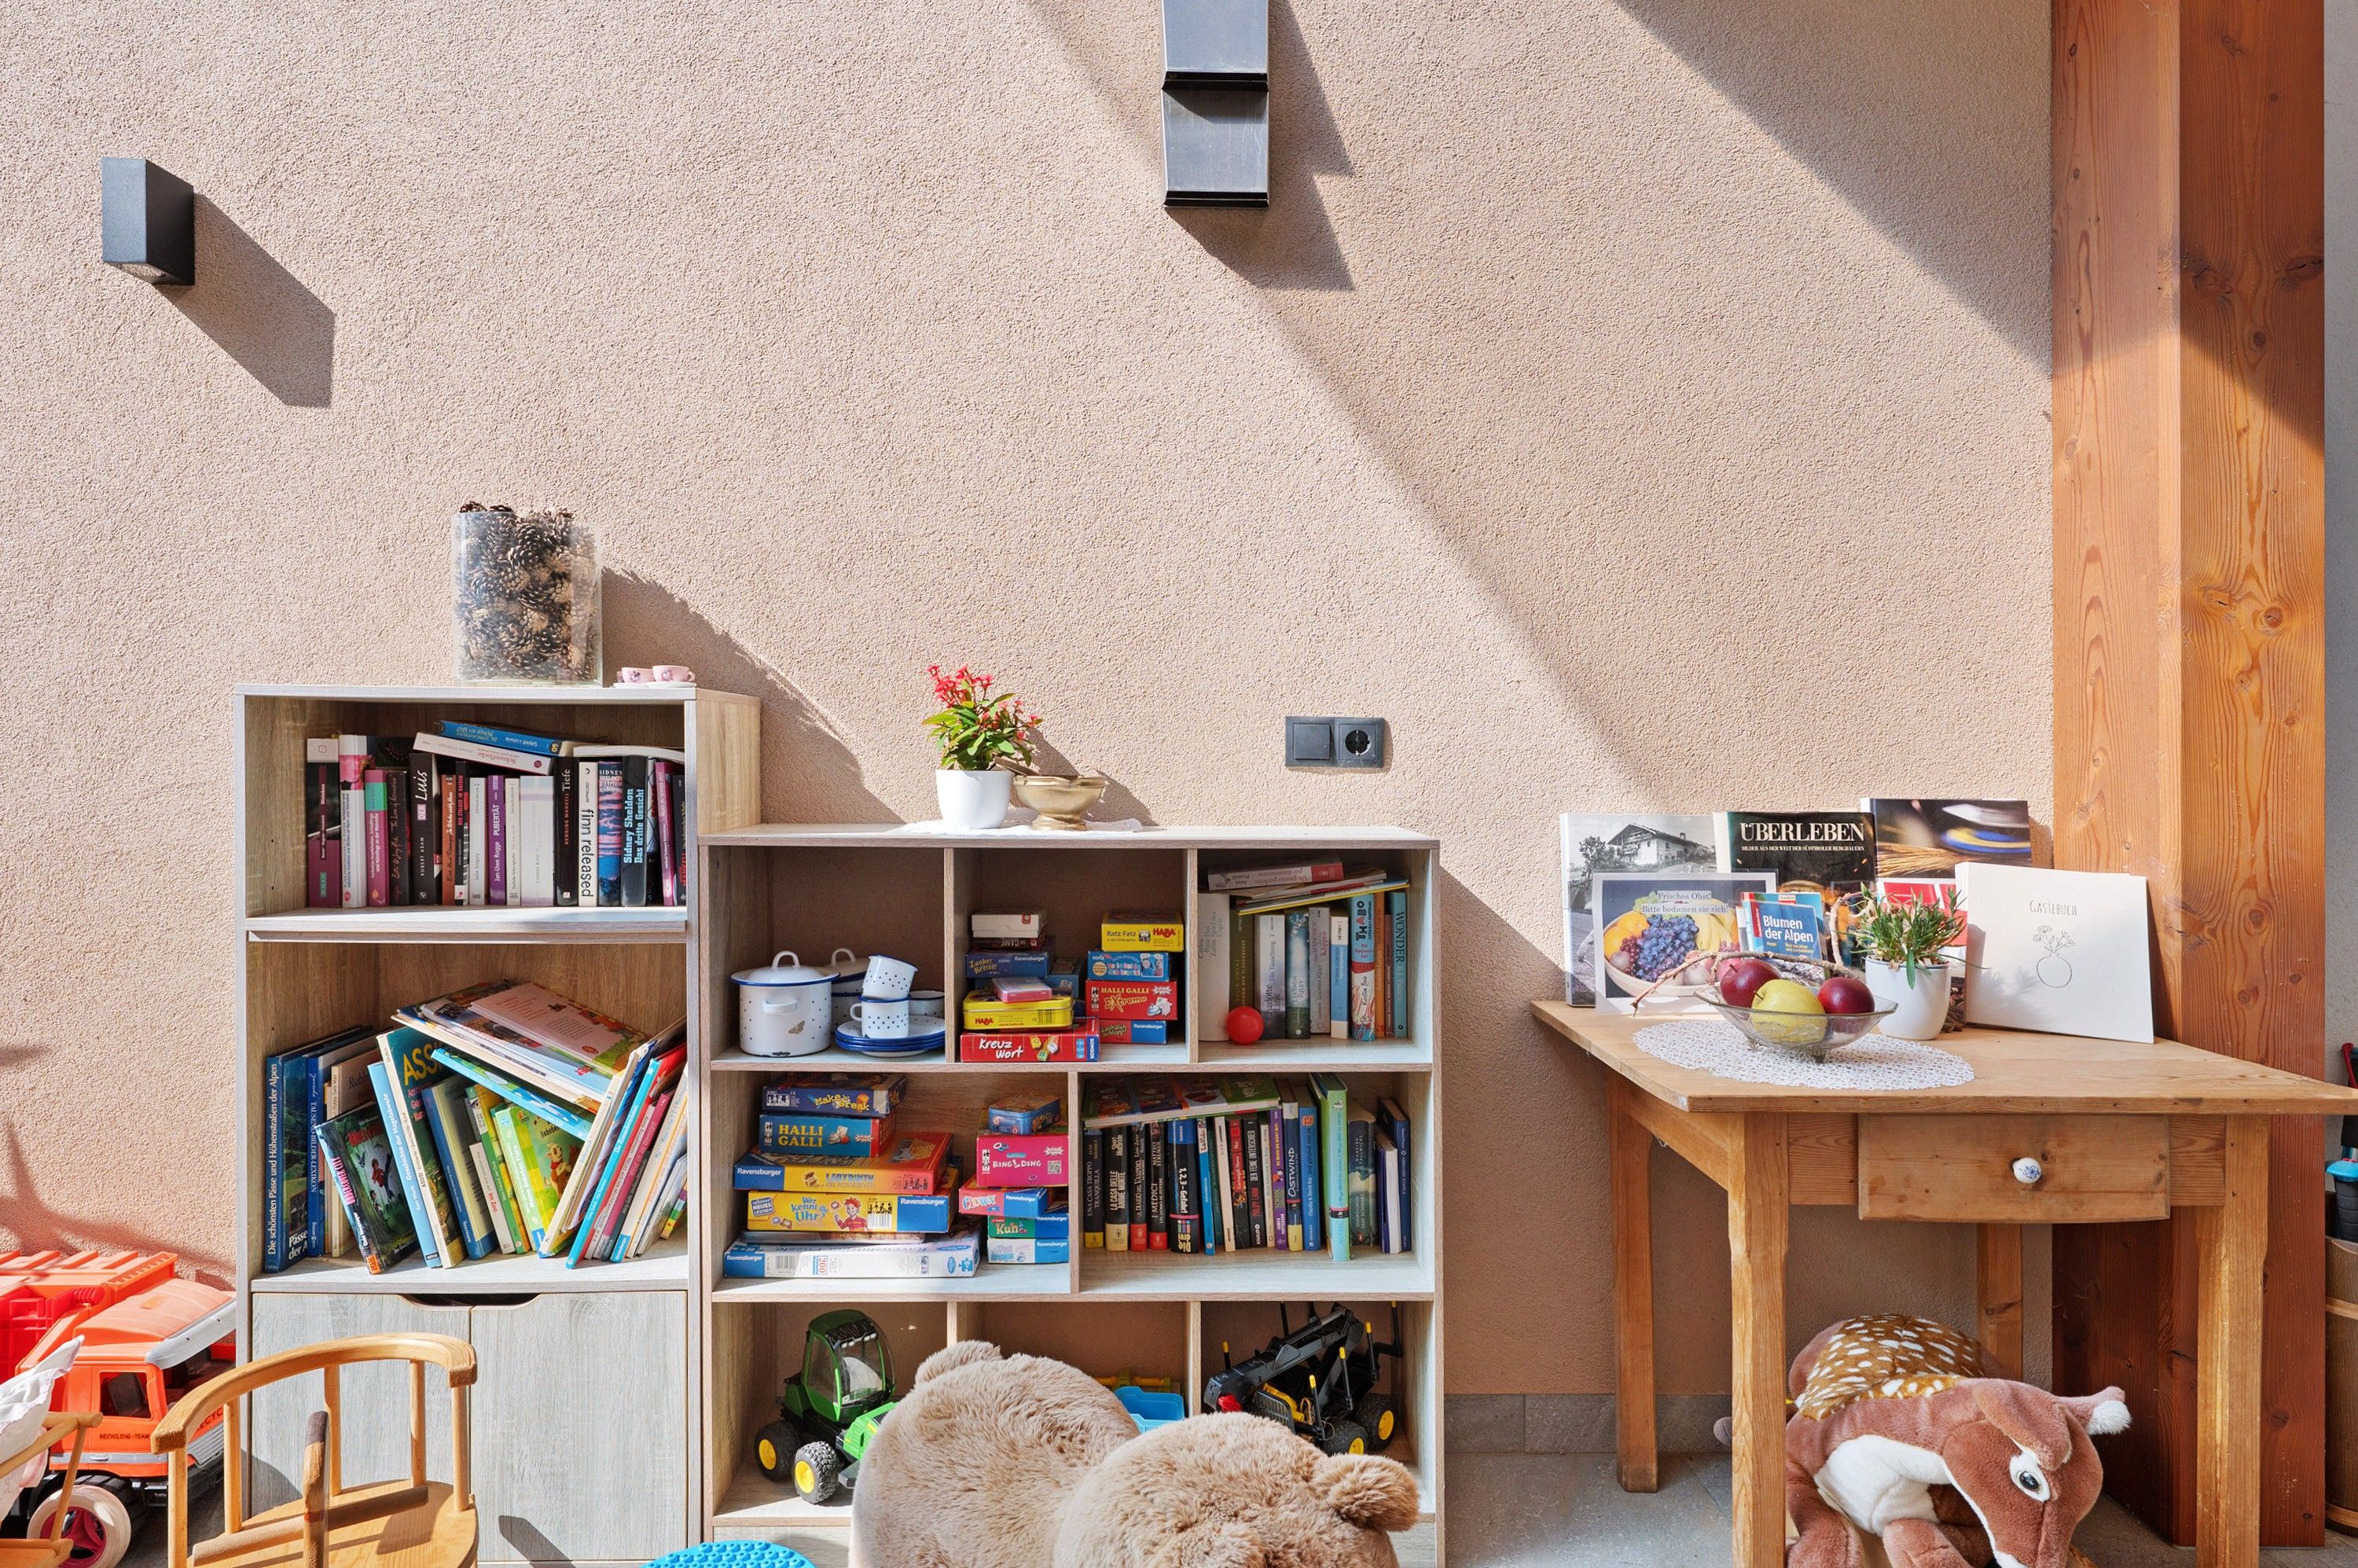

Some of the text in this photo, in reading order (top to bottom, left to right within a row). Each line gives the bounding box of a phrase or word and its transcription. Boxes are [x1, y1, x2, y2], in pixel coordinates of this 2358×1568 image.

[477, 752, 516, 765] Schneeflocke
[413, 770, 428, 801] Luis
[562, 769, 571, 791] Tiefe
[491, 804, 500, 835] PUBERTÄT
[623, 788, 634, 864] Sidney Sheldon
[634, 788, 644, 864] Das dritte Gesicht
[1740, 822, 1865, 842] ÜBERLEBEN
[581, 809, 594, 898] finn released
[1658, 892, 1711, 901] Frisches Obst!
[1662, 905, 1696, 914] bedienen
[1699, 905, 1709, 914] sie
[1711, 905, 1728, 914] sich!
[1355, 901, 1368, 942] THABO
[1763, 915, 1803, 930] Blumen
[1153, 928, 1177, 939] HABA
[1395, 912, 1405, 964] WONDER
[1765, 927, 1814, 944] der Alpen
[969, 958, 993, 968] Zauber
[1265, 984, 1273, 1020] Charlotte
[814, 1094, 841, 1107] Make
[839, 1099, 870, 1111] Break
[381, 1091, 413, 1181] Geschichte der Hagelabwehr
[779, 1125, 824, 1137] HALLI
[777, 1136, 823, 1148] GALLI
[1247, 1130, 1257, 1159] UNTERSCHIED
[267, 1063, 278, 1254] Die schönsten Pässe und Höhenstraßen der Alpen
[737, 1167, 781, 1177] Ravensburger
[825, 1173, 875, 1183] LABYRINTH
[1287, 1148, 1296, 1197] OSTWIND
[331, 1156, 356, 1206] UNDERCOVER CITY
[418, 1172, 427, 1188] ASSISI
[791, 1203, 817, 1214] kennt
[802, 1197, 817, 1206] Wer
[901, 1198, 946, 1206] Ravensburger
[1179, 1191, 1188, 1214] Gefahr!
[795, 1211, 826, 1221] Uhr?
[995, 1222, 1019, 1235] Kuh
[360, 1234, 369, 1247] Gabi
[288, 1246, 303, 1260] der
